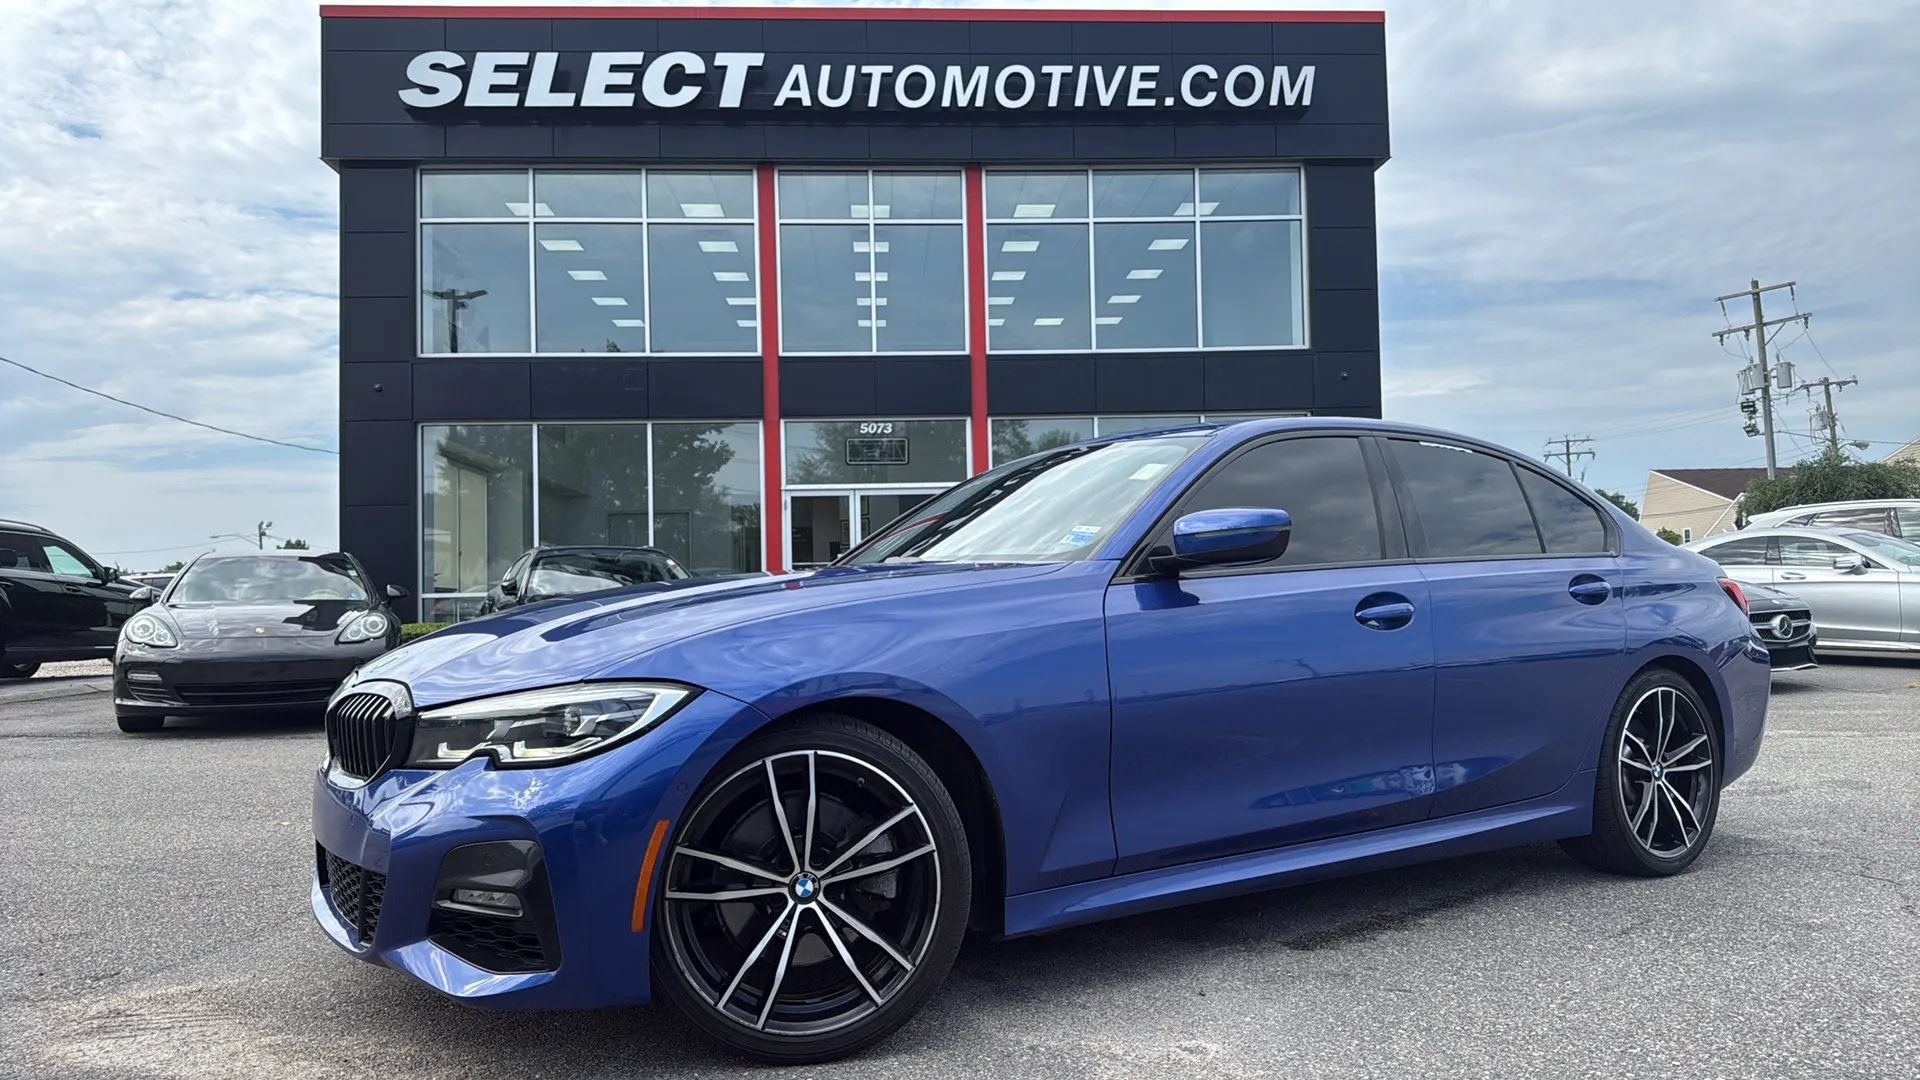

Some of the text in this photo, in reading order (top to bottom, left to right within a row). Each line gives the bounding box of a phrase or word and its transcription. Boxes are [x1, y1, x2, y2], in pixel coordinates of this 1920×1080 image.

[398, 51, 1316, 108] SELECT AUTOMOTIVE.COM
[860, 423, 893, 434] 5073
